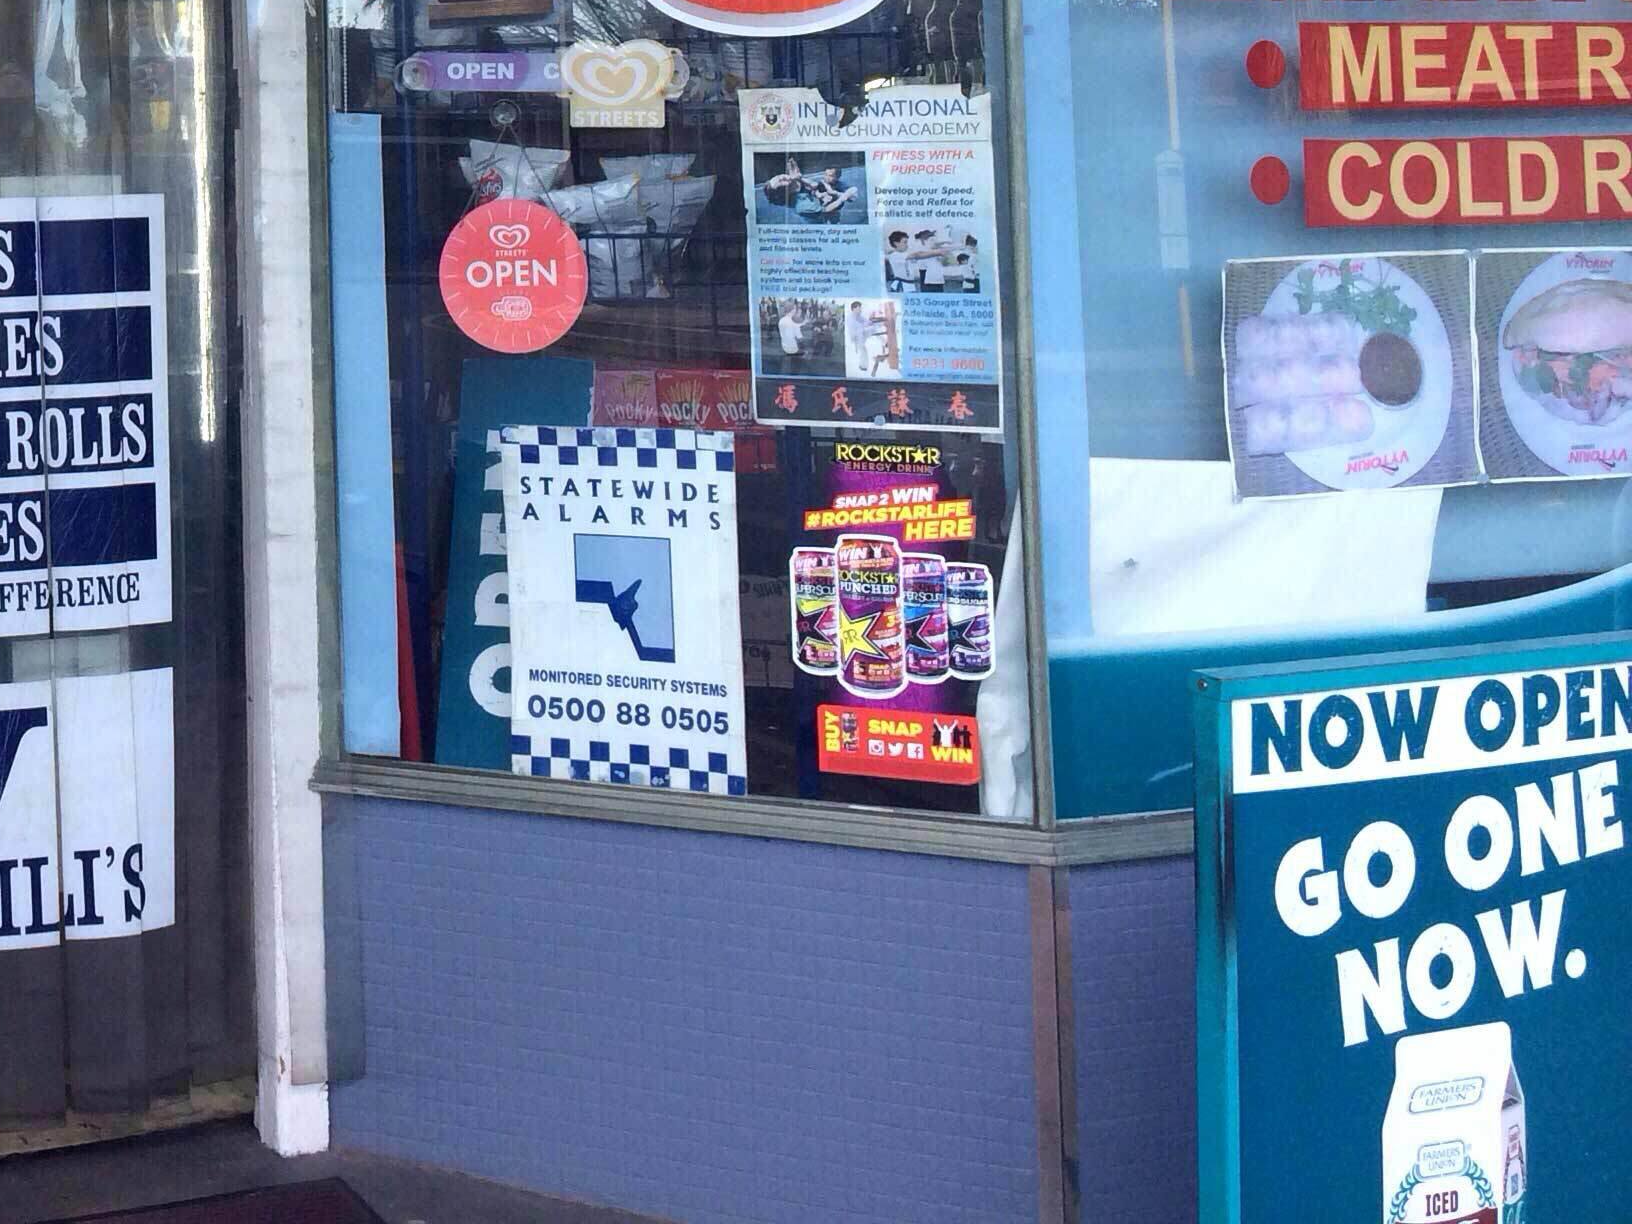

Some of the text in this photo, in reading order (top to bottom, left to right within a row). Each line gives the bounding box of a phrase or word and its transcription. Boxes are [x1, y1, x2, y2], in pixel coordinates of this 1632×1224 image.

[447, 61, 515, 80] OPEN
[1328, 24, 1553, 105] MEAT
[574, 111, 660, 127] STREETS
[798, 99, 978, 118] INTNATIONAL
[797, 122, 980, 138] WING CHUN ACADEMY
[873, 149, 961, 161] FITNESS WITH
[1328, 139, 1560, 221] COLD
[874, 186, 938, 196] Develop your
[906, 197, 975, 206] and Reflex for
[915, 209, 933, 217] self
[465, 259, 557, 287] OPEN
[5, 401, 149, 471] ROLLS
[845, 461, 931, 474] ENERGY DRINK
[520, 476, 721, 504] STATEWIDE
[835, 486, 934, 509] SNAP 2 WIN
[522, 502, 721, 530] ALARMS
[806, 501, 970, 528] #ROCKSTARLIFE
[905, 517, 974, 541] HERE
[839, 546, 868, 561] WIN
[529, 669, 728, 698] MONITORED SECURITY SYSTEMS
[527, 694, 730, 735] 0500 88 0505
[1249, 665, 1632, 776] NOW OPEN
[824, 710, 841, 753] BUY
[868, 719, 924, 737] SNAP
[930, 745, 974, 764] WIN
[1274, 759, 1626, 938] GO ONE
[1334, 888, 1588, 1047] NOW.
[1419, 1082, 1477, 1098] FARMERS
[1425, 1092, 1467, 1107] UNION
[1423, 1146, 1461, 1160] FARMERS
[1428, 1158, 1456, 1171] UNION
[1425, 1190, 1459, 1217] ICED
